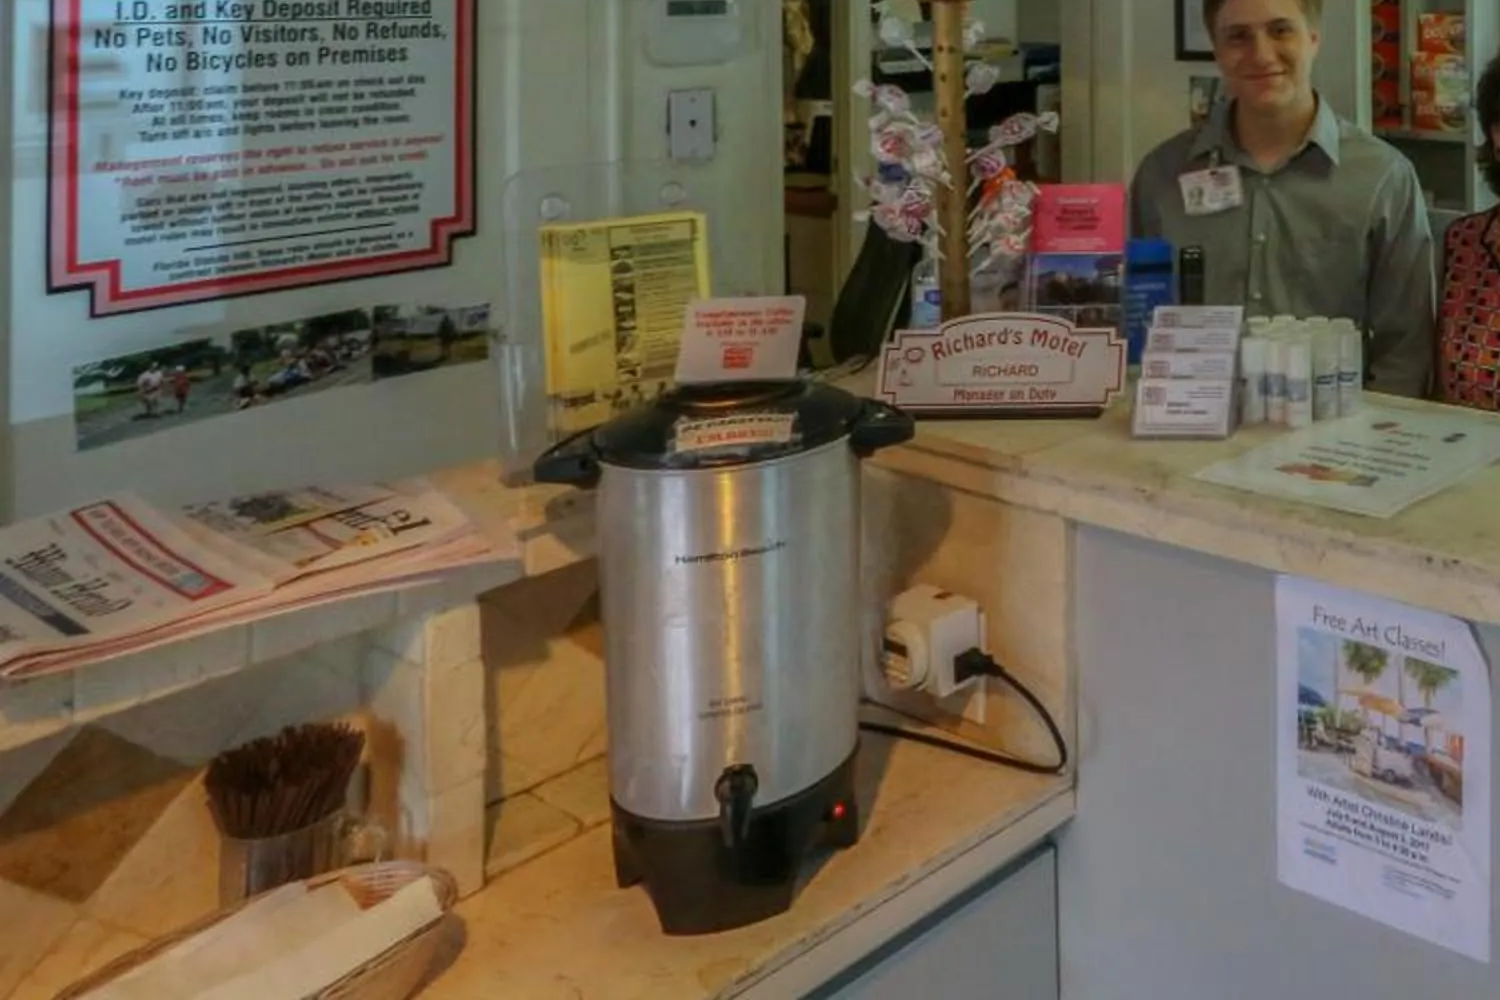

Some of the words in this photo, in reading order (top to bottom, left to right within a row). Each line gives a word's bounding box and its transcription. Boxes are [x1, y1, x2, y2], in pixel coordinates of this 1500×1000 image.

[114, 0, 158, 23] I.D.
[166, 1, 208, 21] and
[216, 0, 255, 24] Key
[263, 0, 341, 24] Deposit
[94, 28, 127, 50] No
[136, 28, 194, 50] Pets,
[202, 26, 233, 46] No
[240, 22, 326, 46] Visitors,
[331, 21, 361, 42] No
[365, 18, 449, 42] Refunds,
[146, 52, 178, 73] No
[186, 49, 279, 75] Bicycles
[285, 50, 311, 67] on
[318, 46, 409, 66] Premises
[930, 328, 1023, 361] Richard's
[1031, 328, 1089, 360] Motel
[972, 364, 1040, 378] RICHARD
[1029, 389, 1057, 402] Duty
[1313, 604, 1346, 632] Free
[1350, 617, 1379, 642] Art
[1384, 623, 1446, 663] Classes!
